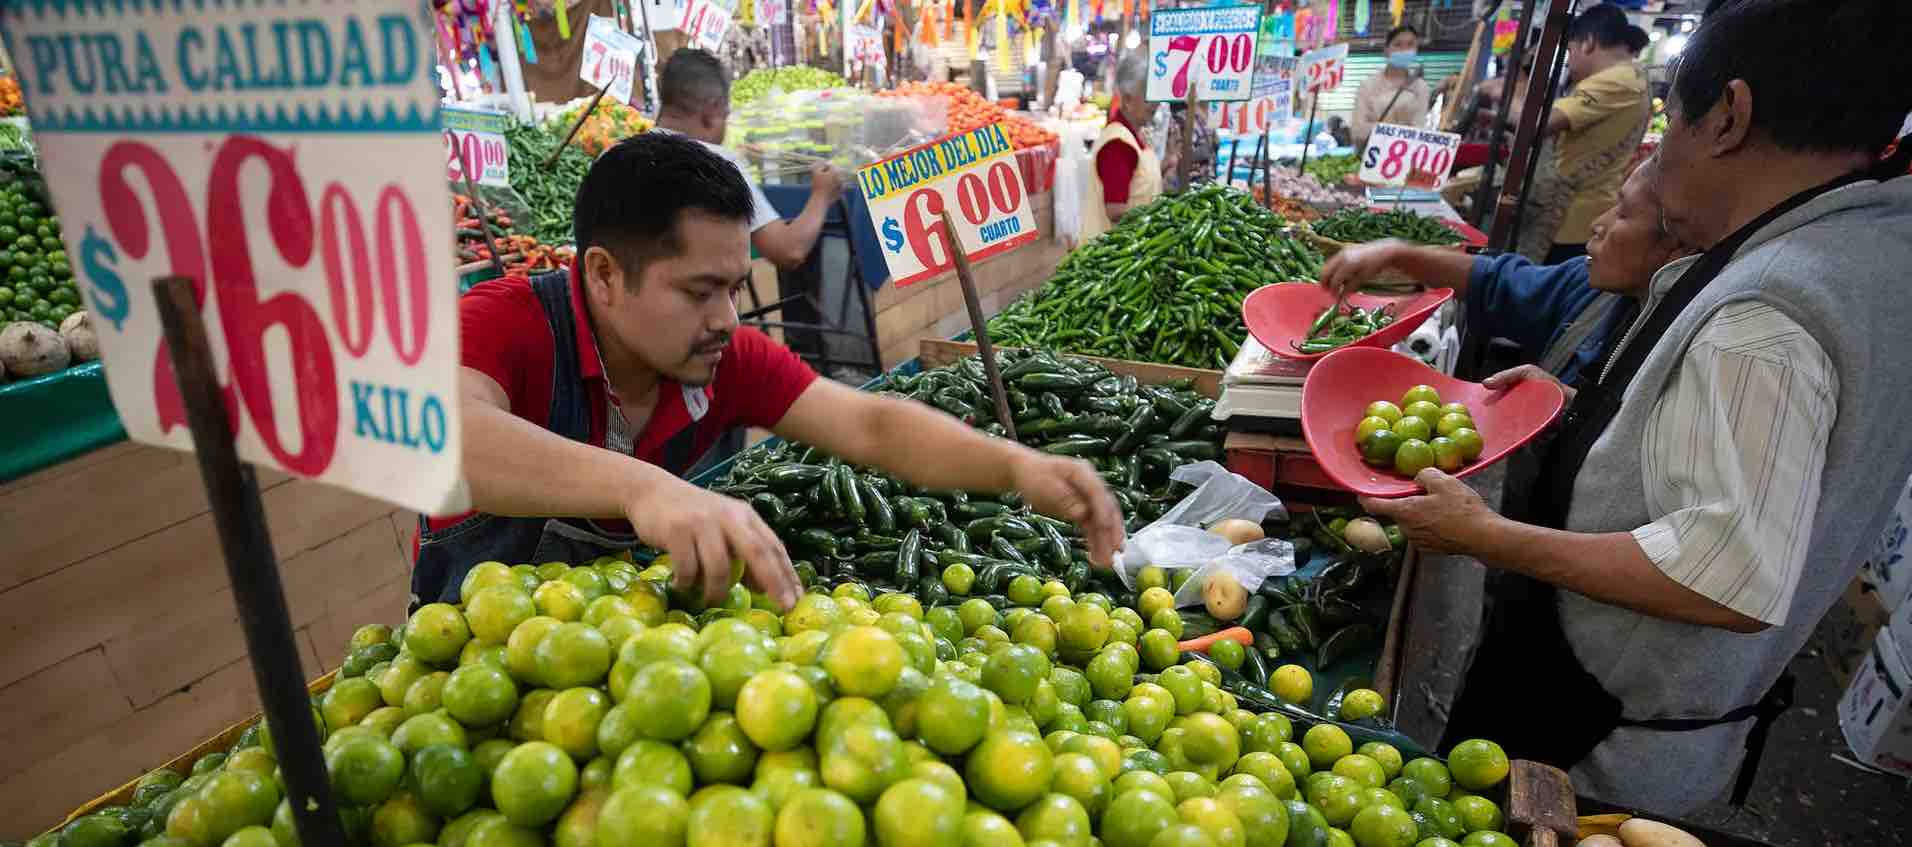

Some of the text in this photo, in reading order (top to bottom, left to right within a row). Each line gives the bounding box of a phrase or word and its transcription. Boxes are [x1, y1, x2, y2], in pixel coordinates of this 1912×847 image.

[26, 15, 416, 95] PURA CALIDAD
[860, 122, 1010, 200] LO MEJOR DEL DIA
[1397, 128, 1417, 140] POR
[979, 216, 1021, 243] CUARTO
[350, 380, 446, 454] KILO
